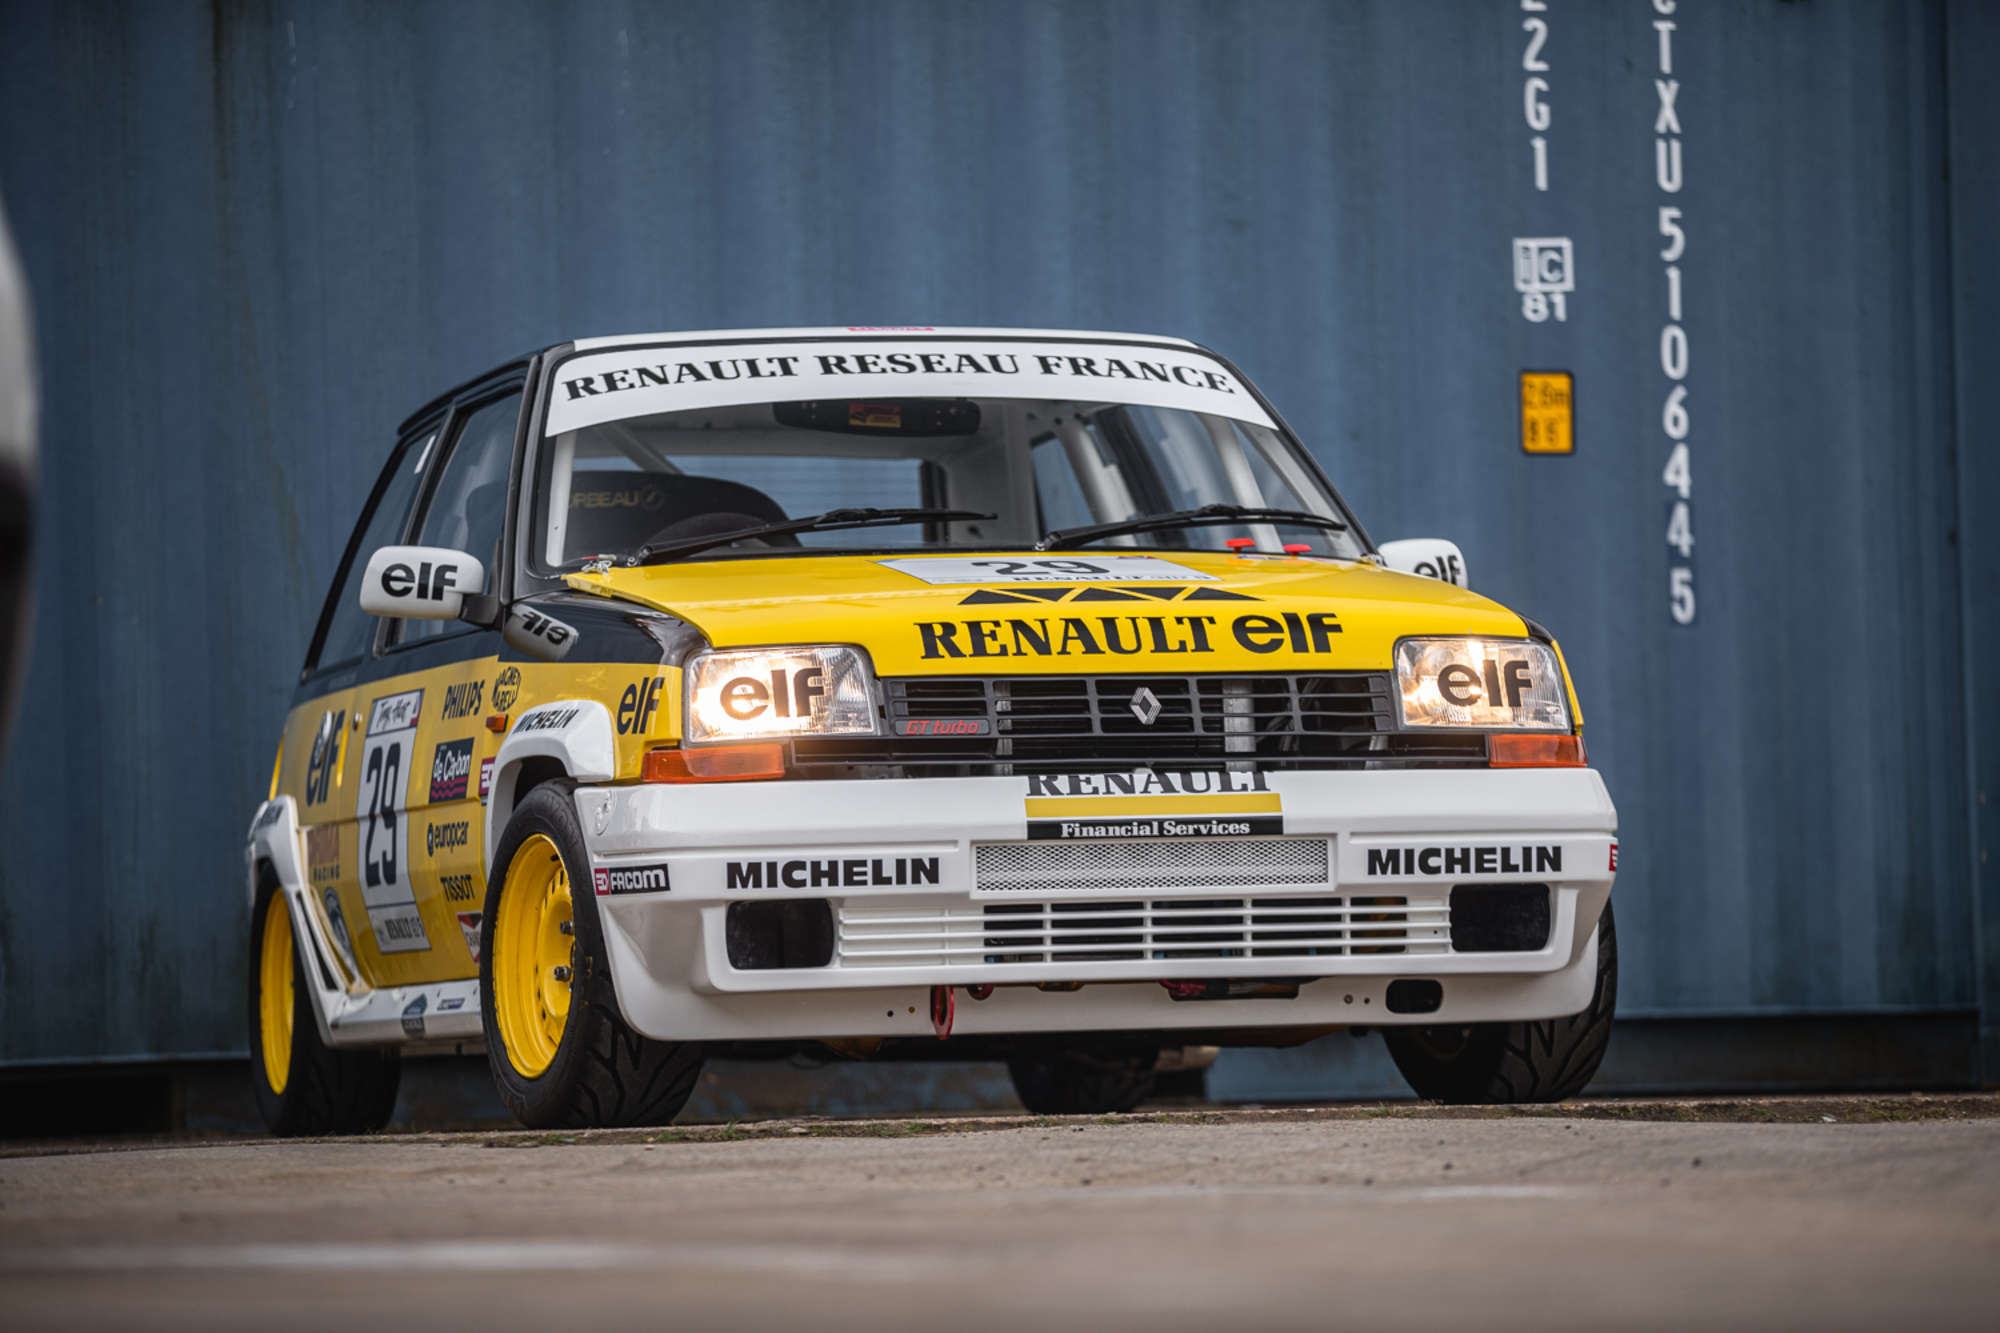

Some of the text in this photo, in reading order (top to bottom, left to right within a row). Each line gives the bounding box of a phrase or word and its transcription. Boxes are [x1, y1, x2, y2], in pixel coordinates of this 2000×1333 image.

[1520, 0, 1550, 191] 2G1
[561, 352, 1236, 401] RENAULT RESEAU FRANCE
[381, 562, 458, 601] elf
[971, 559, 1112, 576] 29
[913, 611, 1344, 660] RENAULT elf
[441, 680, 486, 721] PHILIPS
[719, 667, 825, 721] elf
[1436, 660, 1533, 708] elf
[511, 708, 580, 735] MICHELIN
[617, 676, 665, 736] elf
[905, 719, 980, 735] GT turbo
[306, 709, 346, 808] elf
[365, 741, 401, 888] 29
[1060, 819, 1251, 838] Financial Services
[433, 821, 470, 853] europcar
[726, 857, 940, 889] MICHELIN
[1367, 845, 1563, 876] MICHELIN
[440, 874, 476, 902] TISSOT
